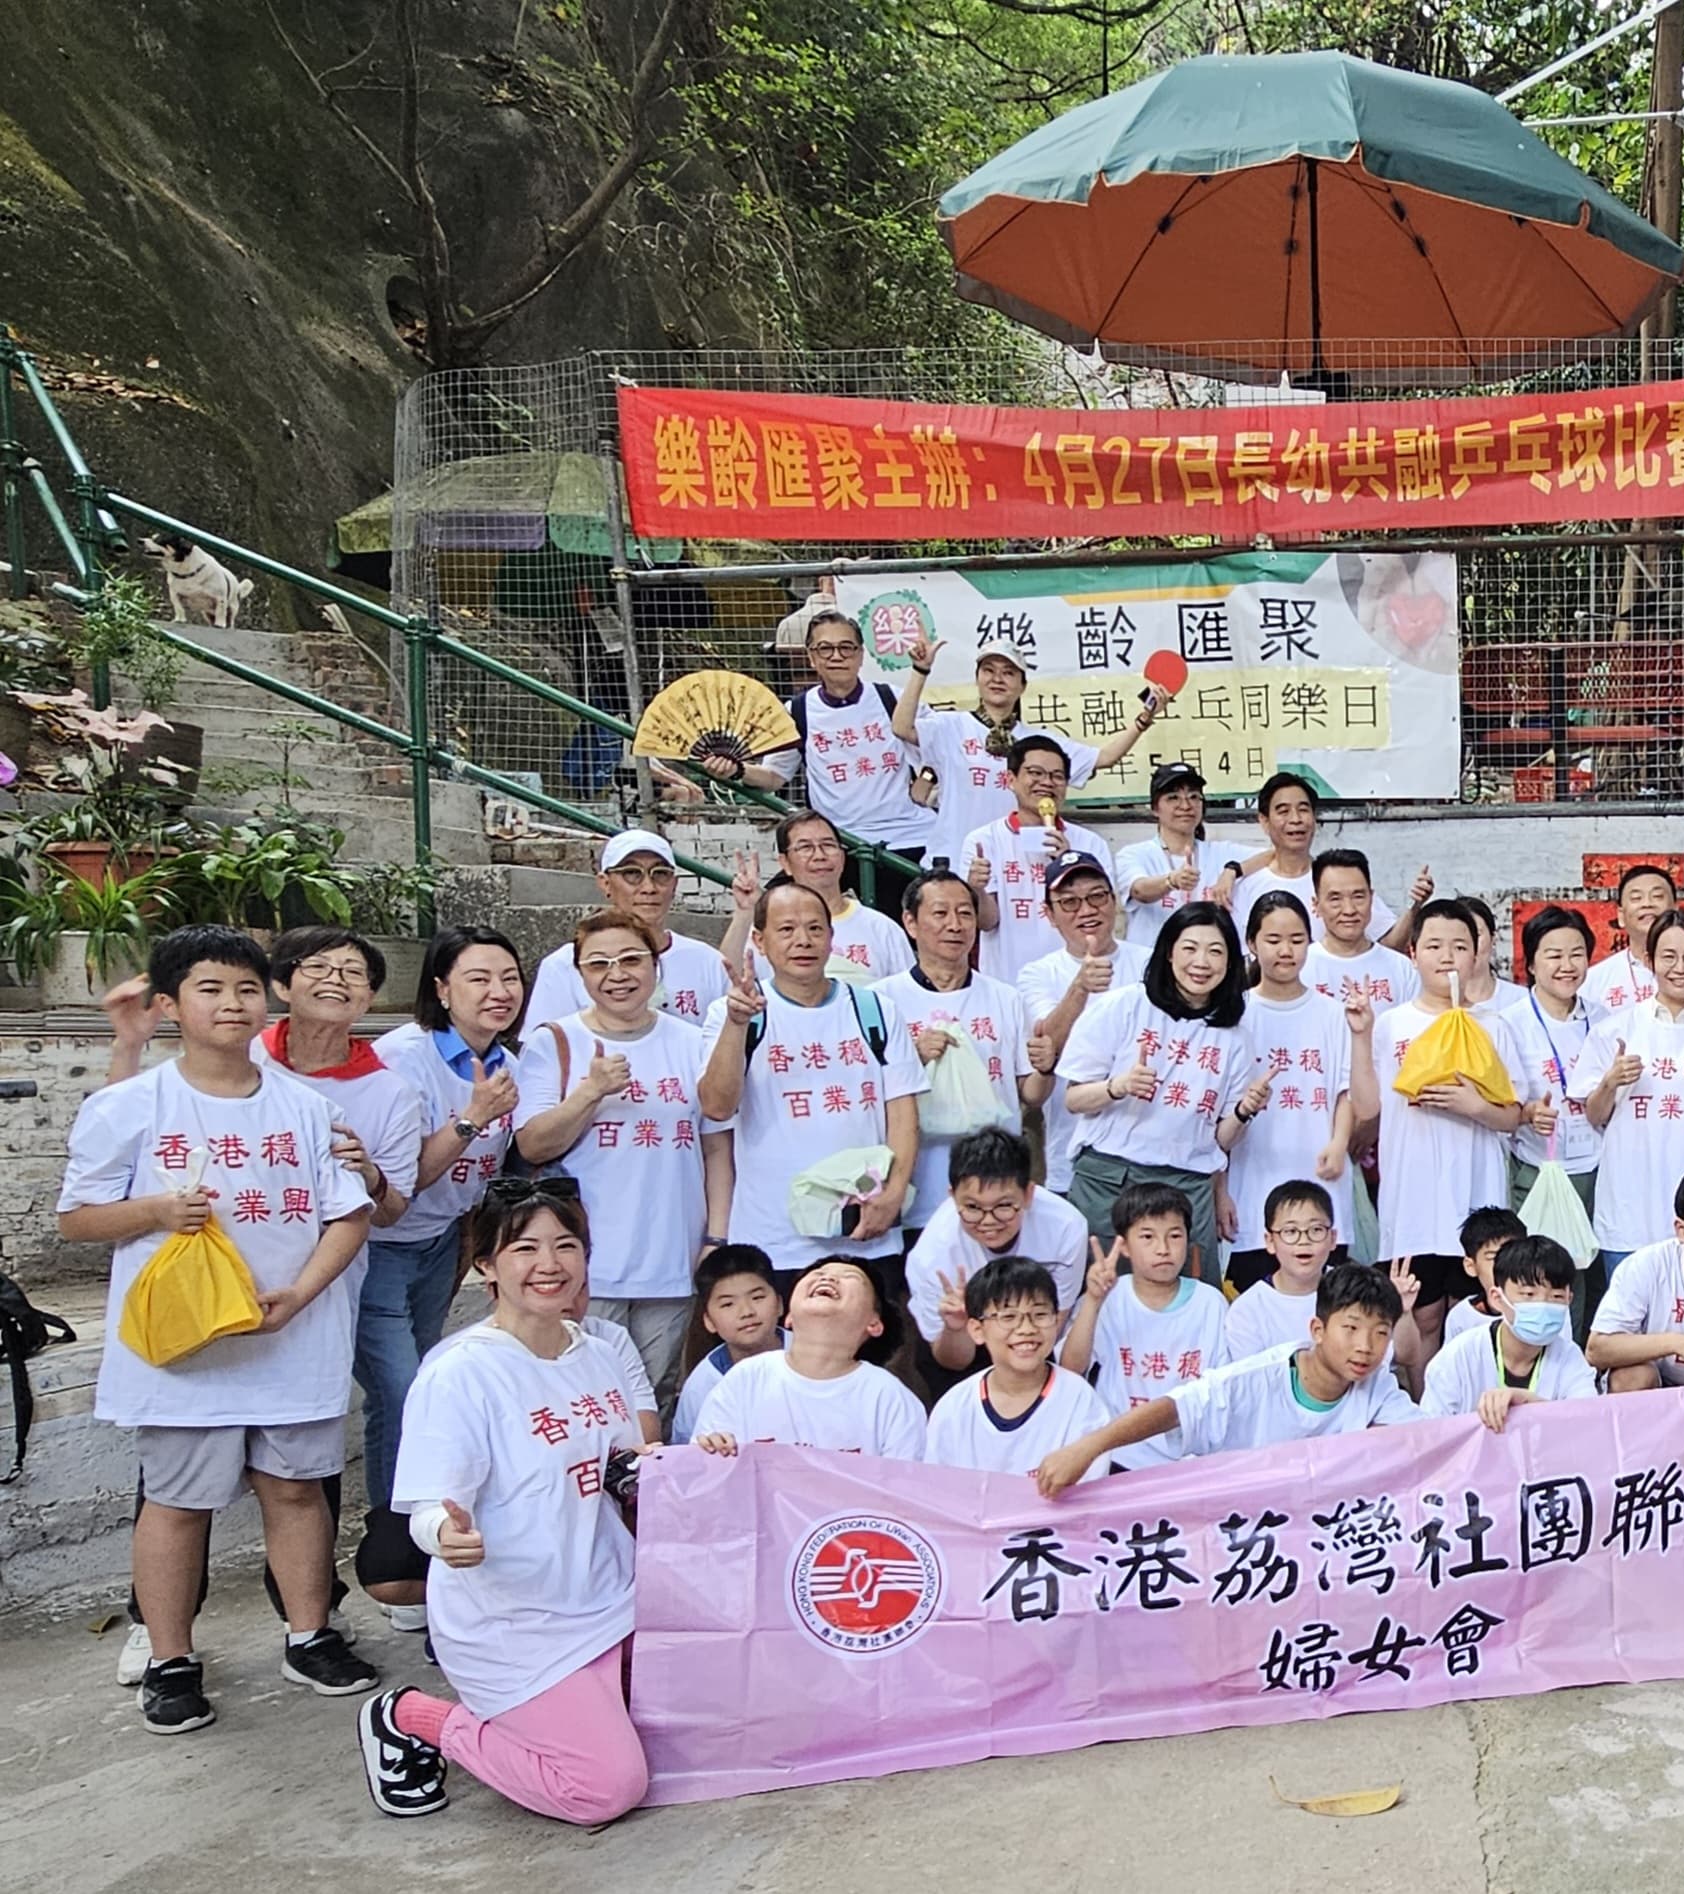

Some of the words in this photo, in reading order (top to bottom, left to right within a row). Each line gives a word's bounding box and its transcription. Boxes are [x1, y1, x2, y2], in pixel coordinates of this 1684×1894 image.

[812, 721, 886, 754] 香港穩
[826, 751, 901, 783] 百業興
[768, 1037, 868, 1073] 香港穩
[1137, 1028, 1221, 1075] 香港穩
[783, 1081, 877, 1119] 百業興
[154, 1130, 301, 1172] 香港穩
[593, 1119, 695, 1150] 百業興
[1119, 1347, 1202, 1379] 香港穩
[530, 1388, 630, 1446] 香港穩
[1259, 1603, 1505, 1693] 婦女會
